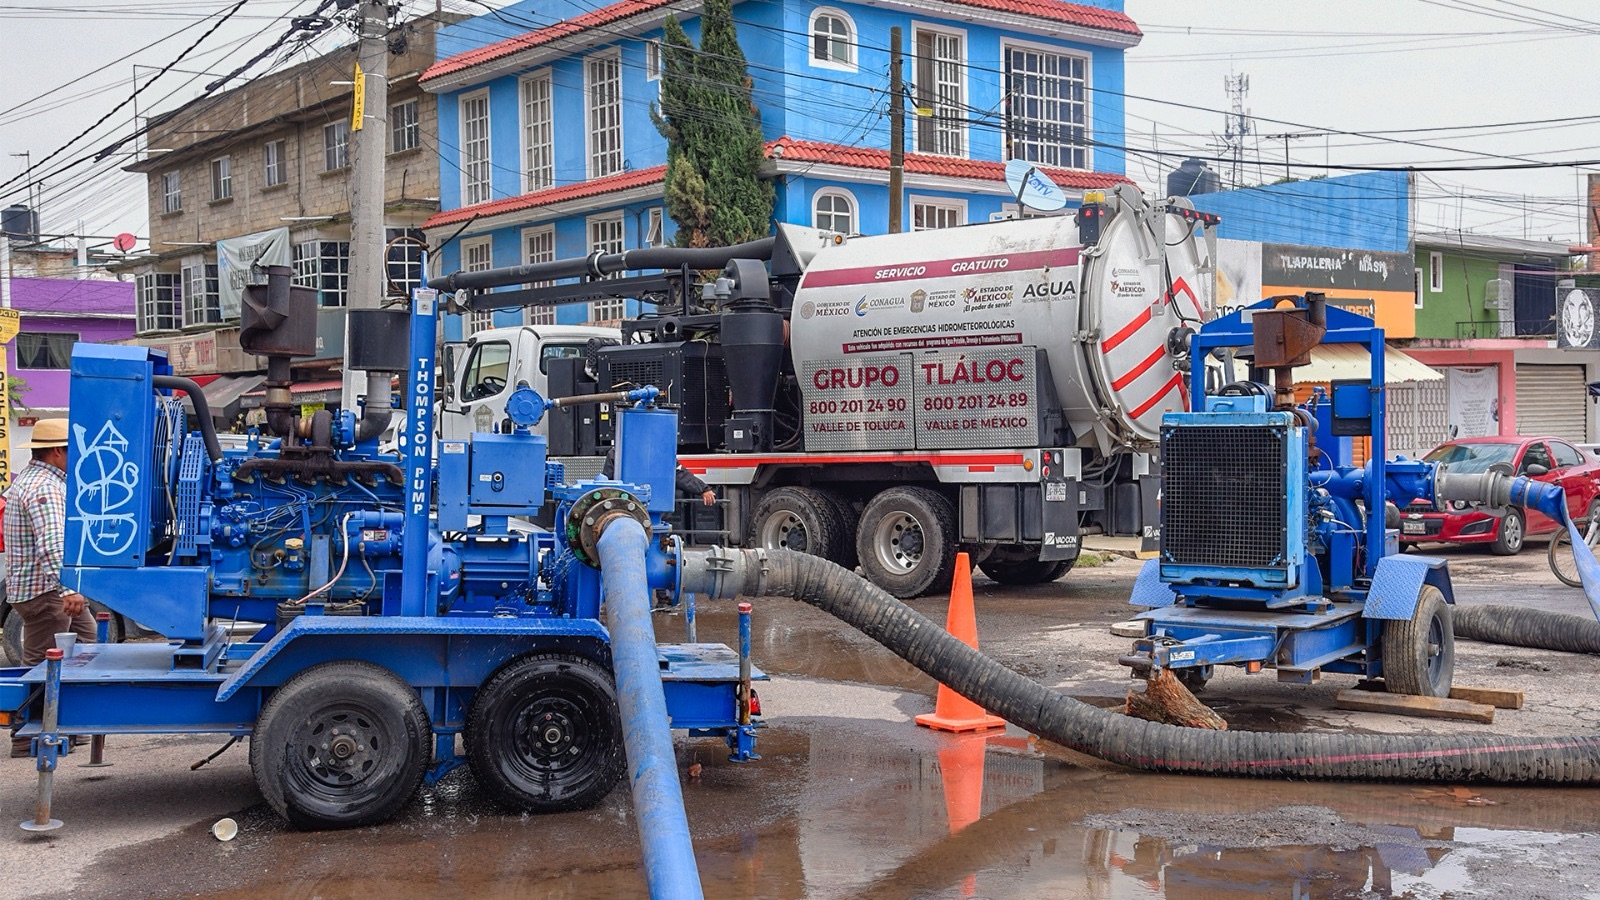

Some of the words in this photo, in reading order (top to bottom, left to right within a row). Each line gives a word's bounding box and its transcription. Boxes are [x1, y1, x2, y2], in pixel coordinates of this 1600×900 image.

[875, 266, 926, 279] SERVICIO
[951, 258, 1009, 272] GRATUITO
[980, 285, 1004, 293] ESTADO
[1022, 280, 1076, 298] AGUA
[870, 297, 904, 307] CONAGUA
[971, 303, 987, 311] poder
[995, 300, 1012, 308] servir!
[815, 307, 850, 317] MÉXICO
[853, 326, 882, 338] ATENCIÓN
[884, 327, 892, 336] DE
[893, 324, 936, 335] EMERGENCIAS
[938, 319, 1015, 332] HIDROMETEOROLÓGICAS
[813, 365, 900, 390] GRUPO
[921, 354, 1025, 385] TLÁLOC
[414, 358, 429, 457] THOMPSON
[810, 401, 837, 414] 800
[840, 400, 863, 413] 201
[867, 398, 884, 412] 24
[887, 398, 906, 412] 90
[924, 396, 954, 411] 800
[957, 395, 983, 409] 201
[987, 394, 1006, 408] 24
[1008, 392, 1028, 407] 89
[812, 422, 844, 432] VALLE
[846, 421, 860, 431] DE
[863, 420, 906, 431] TOLUCA
[924, 420, 960, 431] VALLE
[962, 419, 977, 429] DE
[981, 416, 1028, 429] MÉXICO
[412, 467, 425, 515] PUMP
